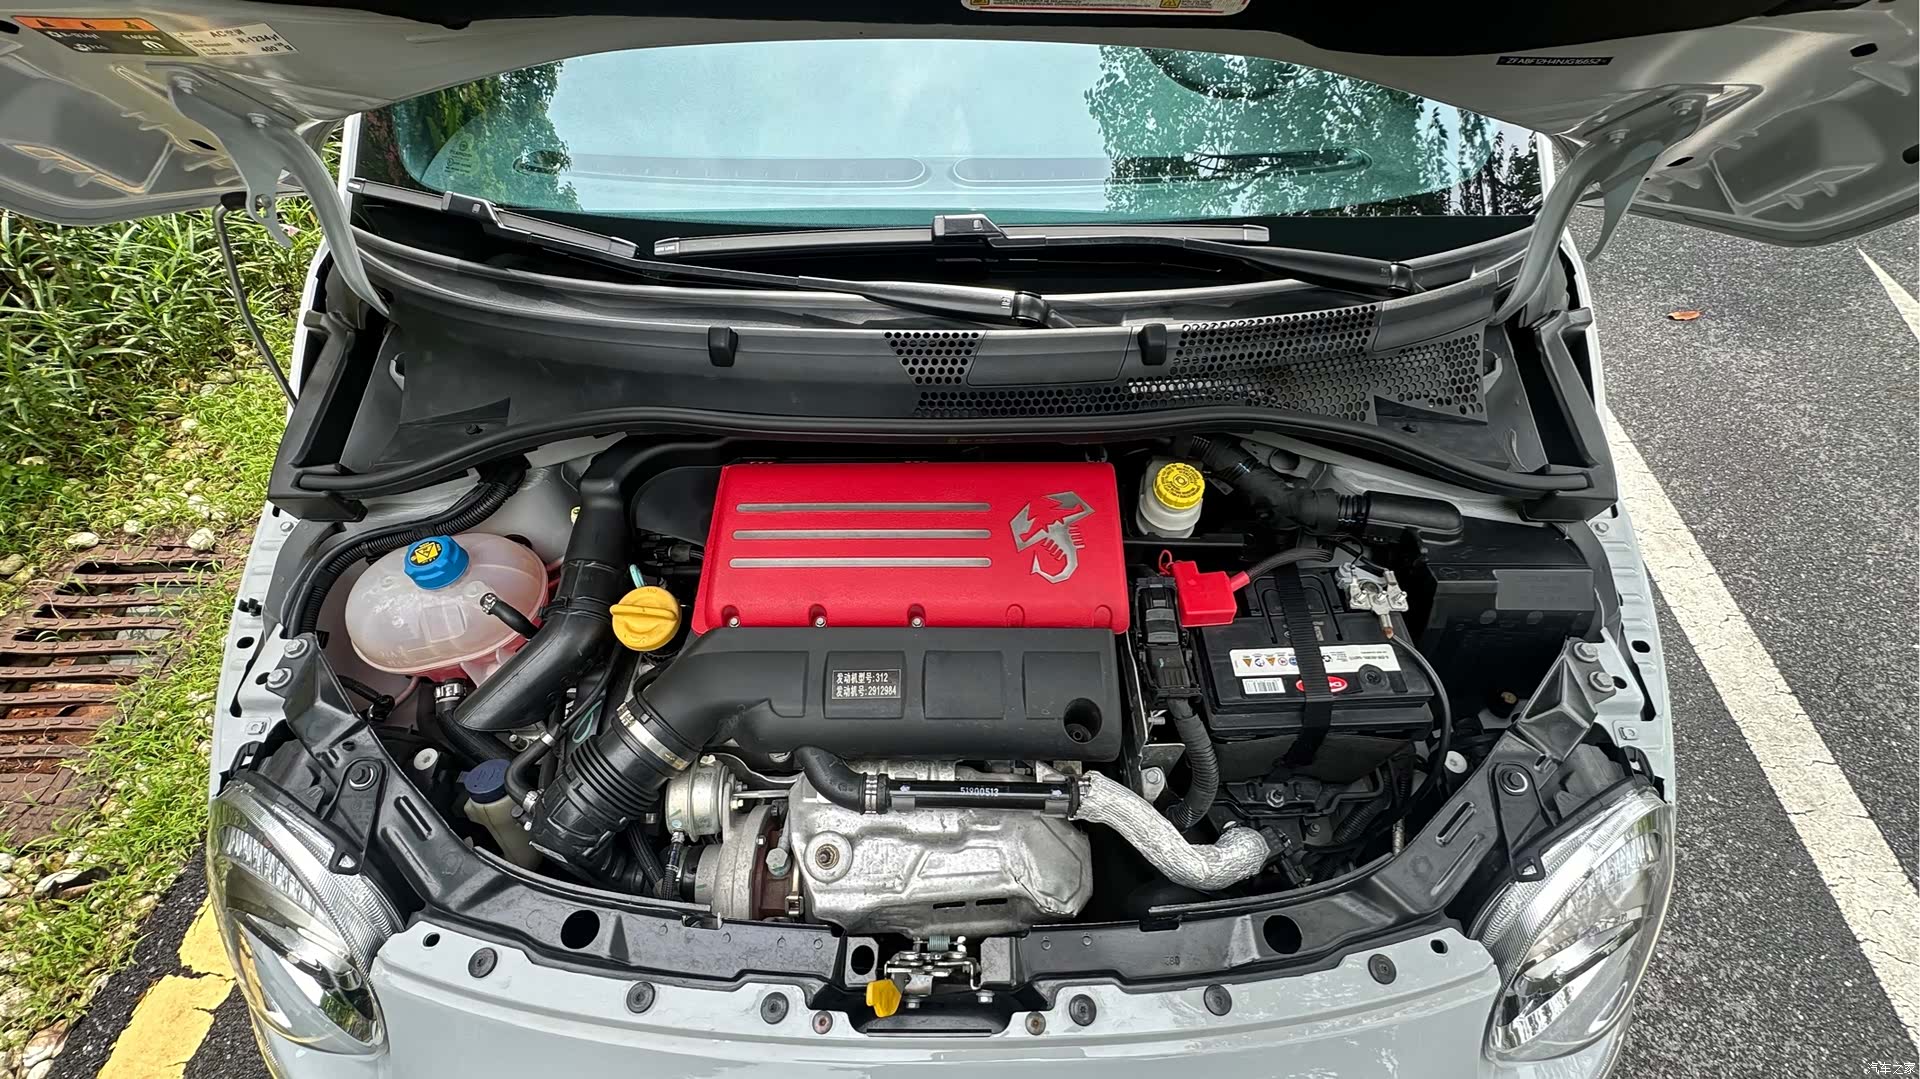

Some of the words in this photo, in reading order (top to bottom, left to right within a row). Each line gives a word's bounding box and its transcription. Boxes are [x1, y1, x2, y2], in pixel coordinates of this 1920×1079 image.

[836, 672, 888, 685] 发动机型号:312
[836, 685, 897, 697] 发动机号:2912984
